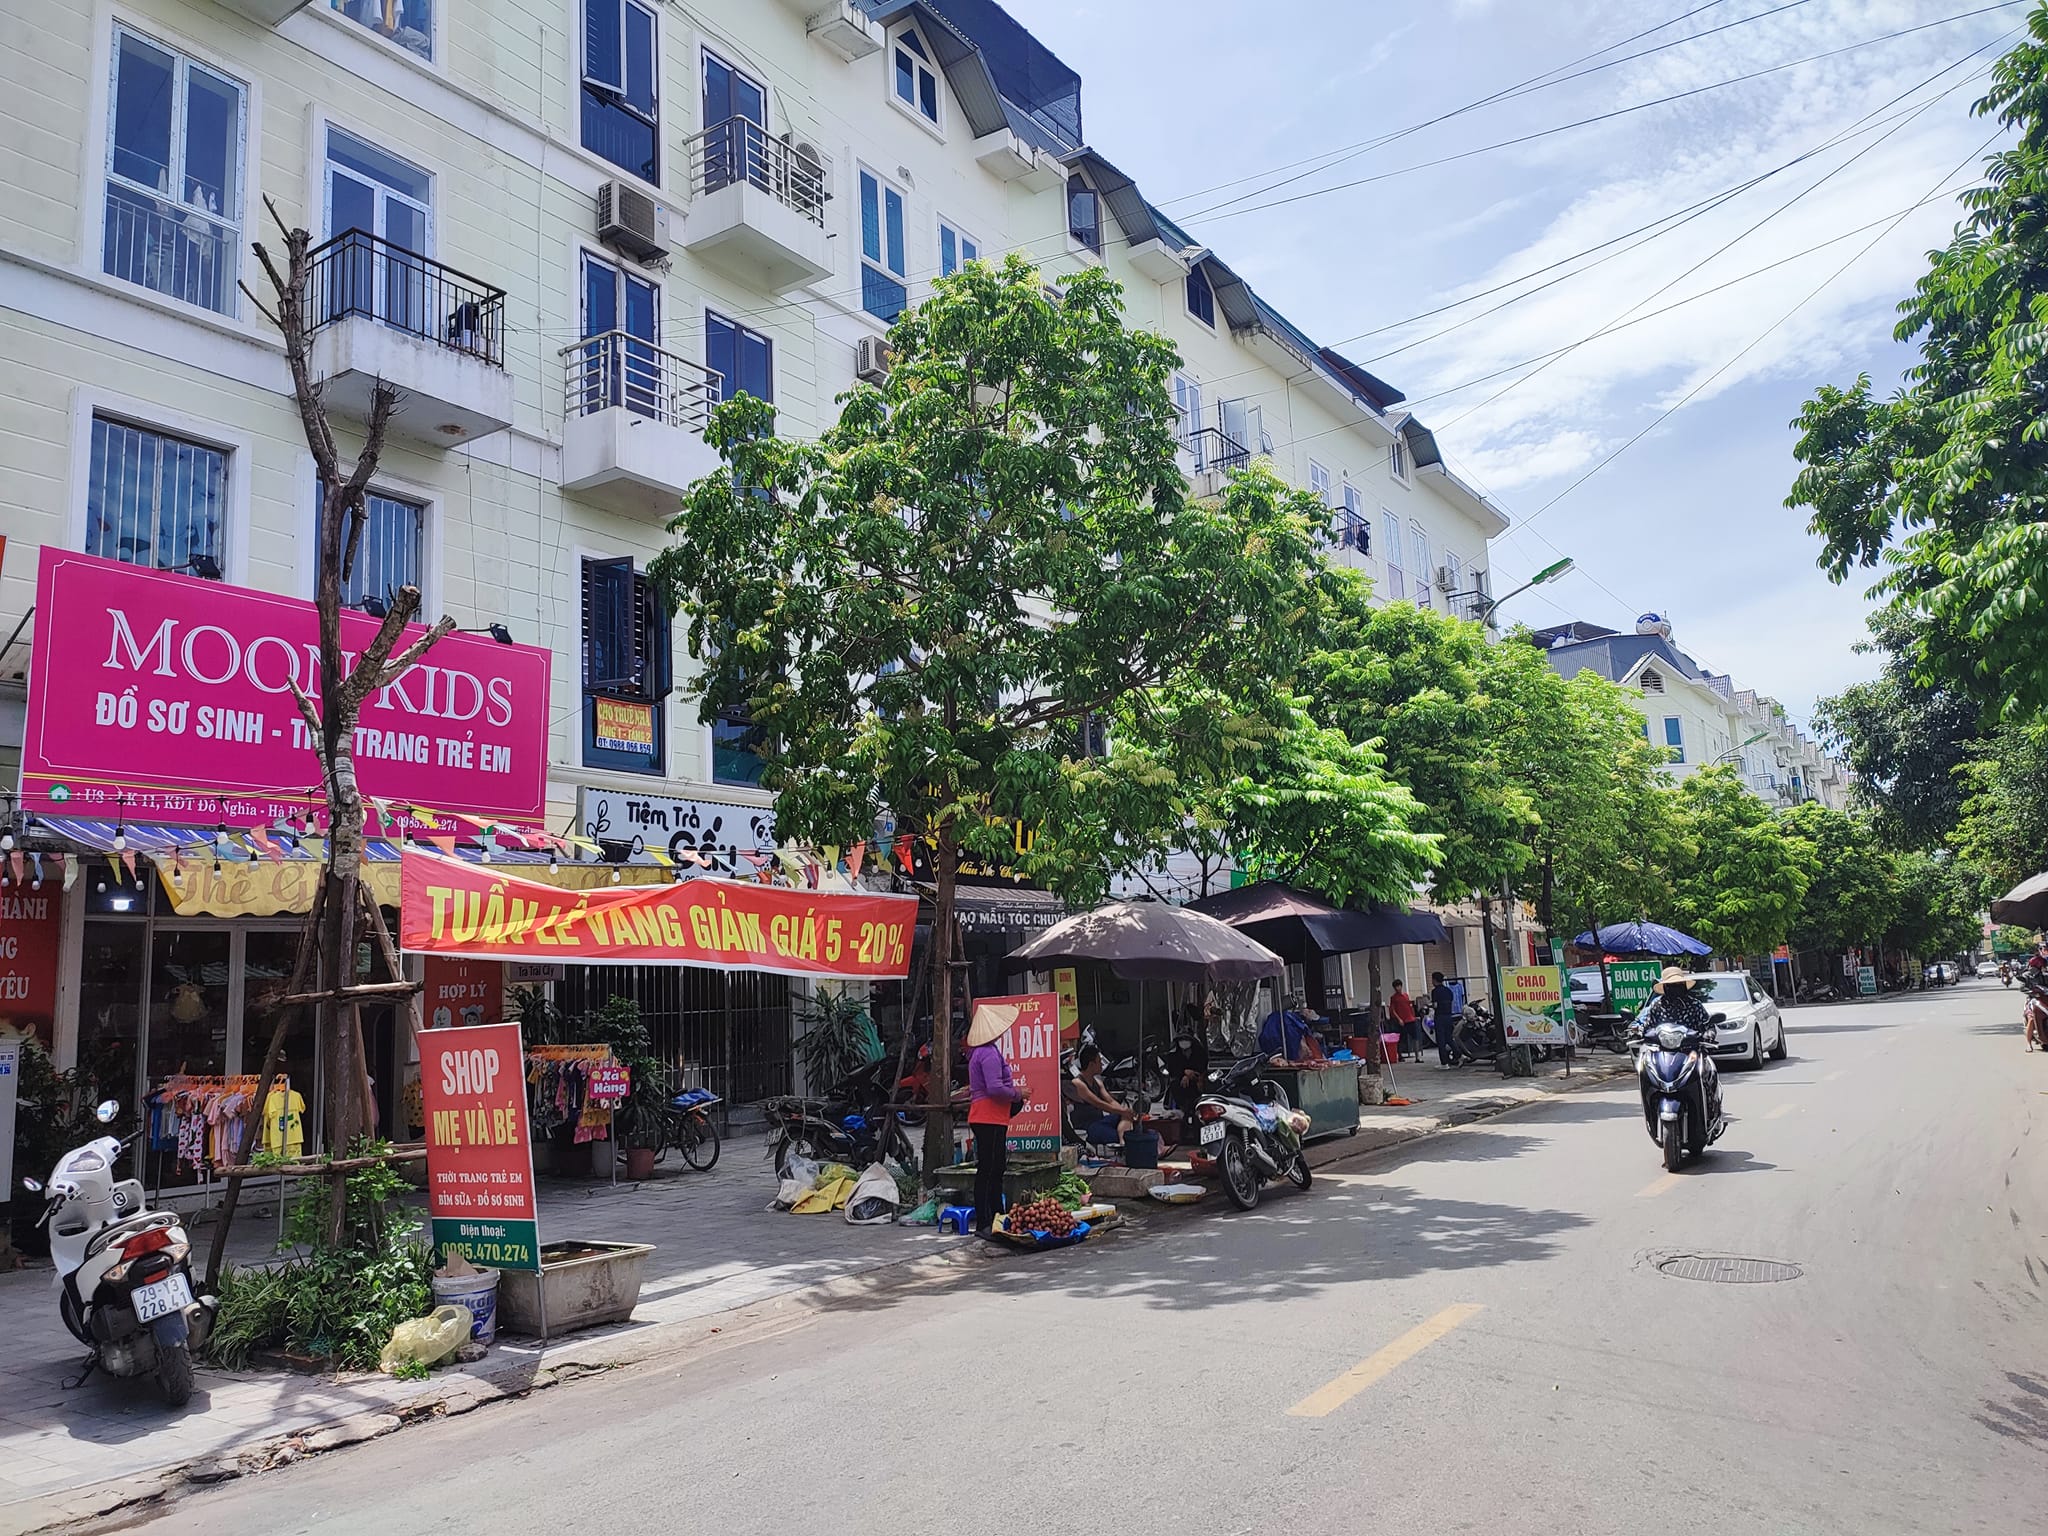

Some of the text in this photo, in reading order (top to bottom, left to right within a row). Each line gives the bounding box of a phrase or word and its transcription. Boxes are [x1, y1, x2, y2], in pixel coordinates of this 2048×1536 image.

[374, 659, 513, 727] KIDS
[95, 684, 139, 729] ĐỒ
[147, 698, 190, 735] SƠ
[196, 705, 264, 744] SINH
[354, 727, 430, 765] TRANG
[436, 729, 474, 769] TRẺ
[480, 743, 512, 774] EM
[626, 801, 700, 831] Tiệm Trà
[669, 816, 736, 873] Gấu
[426, 879, 540, 945] TUẦN
[689, 890, 767, 955] GIẢM
[770, 907, 818, 961] GIÁ
[826, 919, 842, 962] 5
[980, 907, 1005, 924] MẪU
[1008, 910, 1030, 926] TÓC
[438, 980, 487, 1002] HỢP LÝ
[1614, 967, 1638, 982] BÚN
[1019, 1012, 1054, 1059] ĐẤT
[440, 1049, 500, 1096] SHOP
[433, 1100, 518, 1154] MẸ VÀ BÉ
[459, 1173, 488, 1183] TRANG
[490, 1169, 507, 1184] TRẺ
[510, 1173, 522, 1184] EM
[454, 1191, 472, 1206] SỮA
[503, 1194, 525, 1207] SINH
[460, 1224, 506, 1239] Điện thoại:
[140, 1279, 179, 1303] 29-Y3
